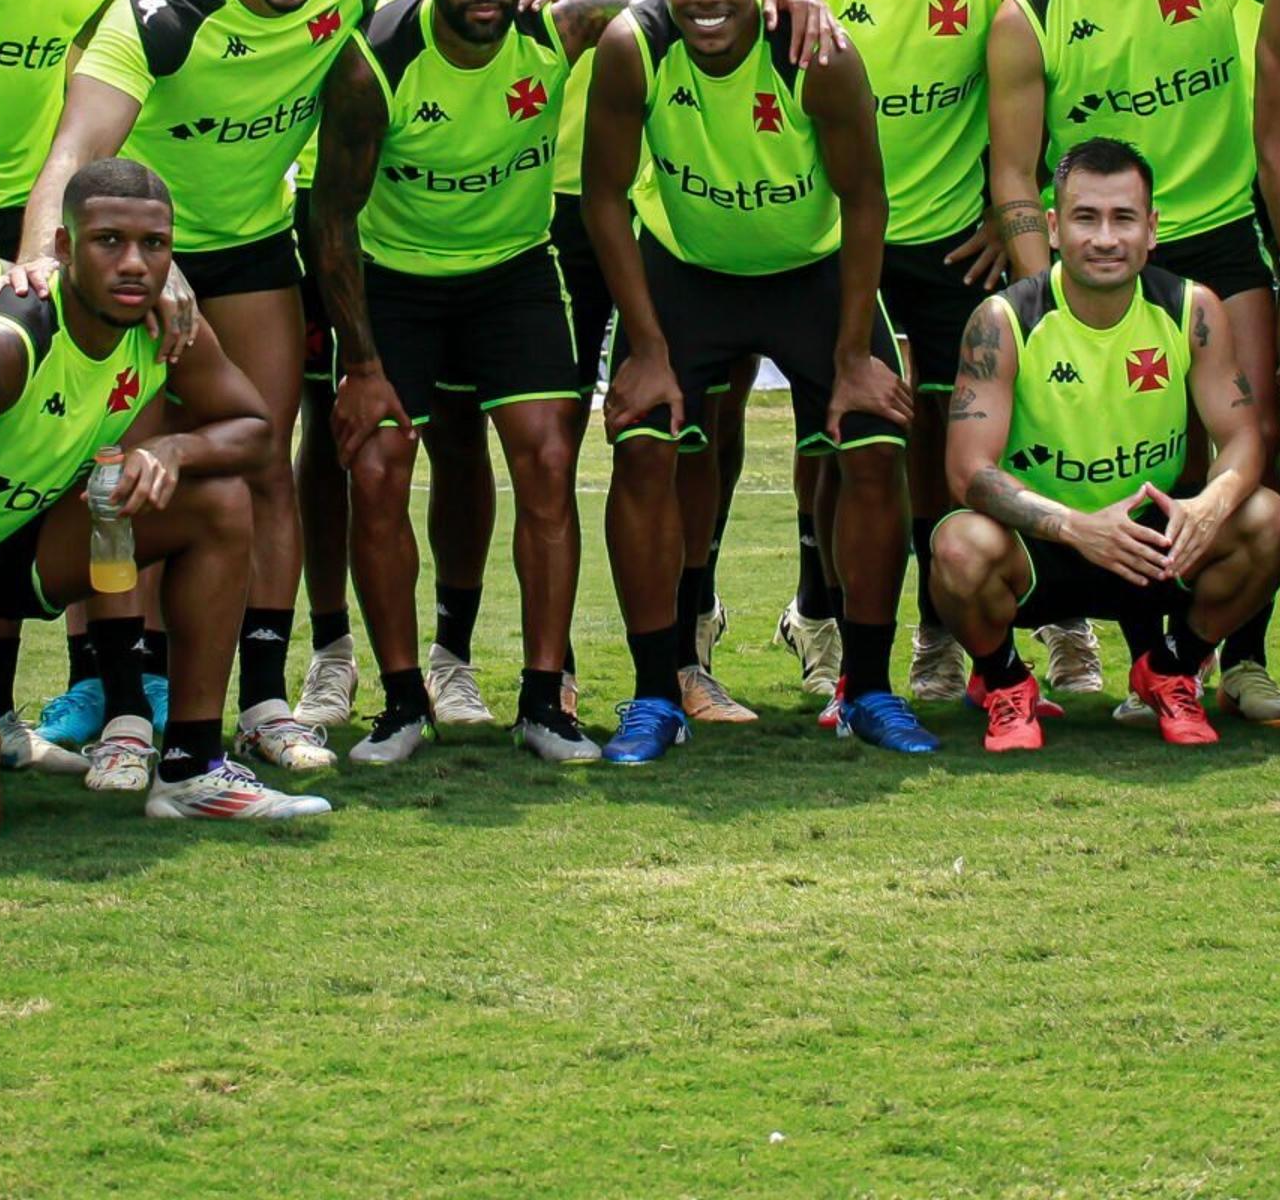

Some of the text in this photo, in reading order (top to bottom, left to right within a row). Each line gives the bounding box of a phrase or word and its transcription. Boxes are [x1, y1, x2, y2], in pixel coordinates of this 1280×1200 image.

[873, 72, 982, 116] etfair
[1106, 56, 1234, 116] betfair
[217, 95, 318, 143] betfa
[426, 135, 558, 193] betfair
[680, 164, 816, 211] betfair
[1056, 430, 1187, 483] betfair
